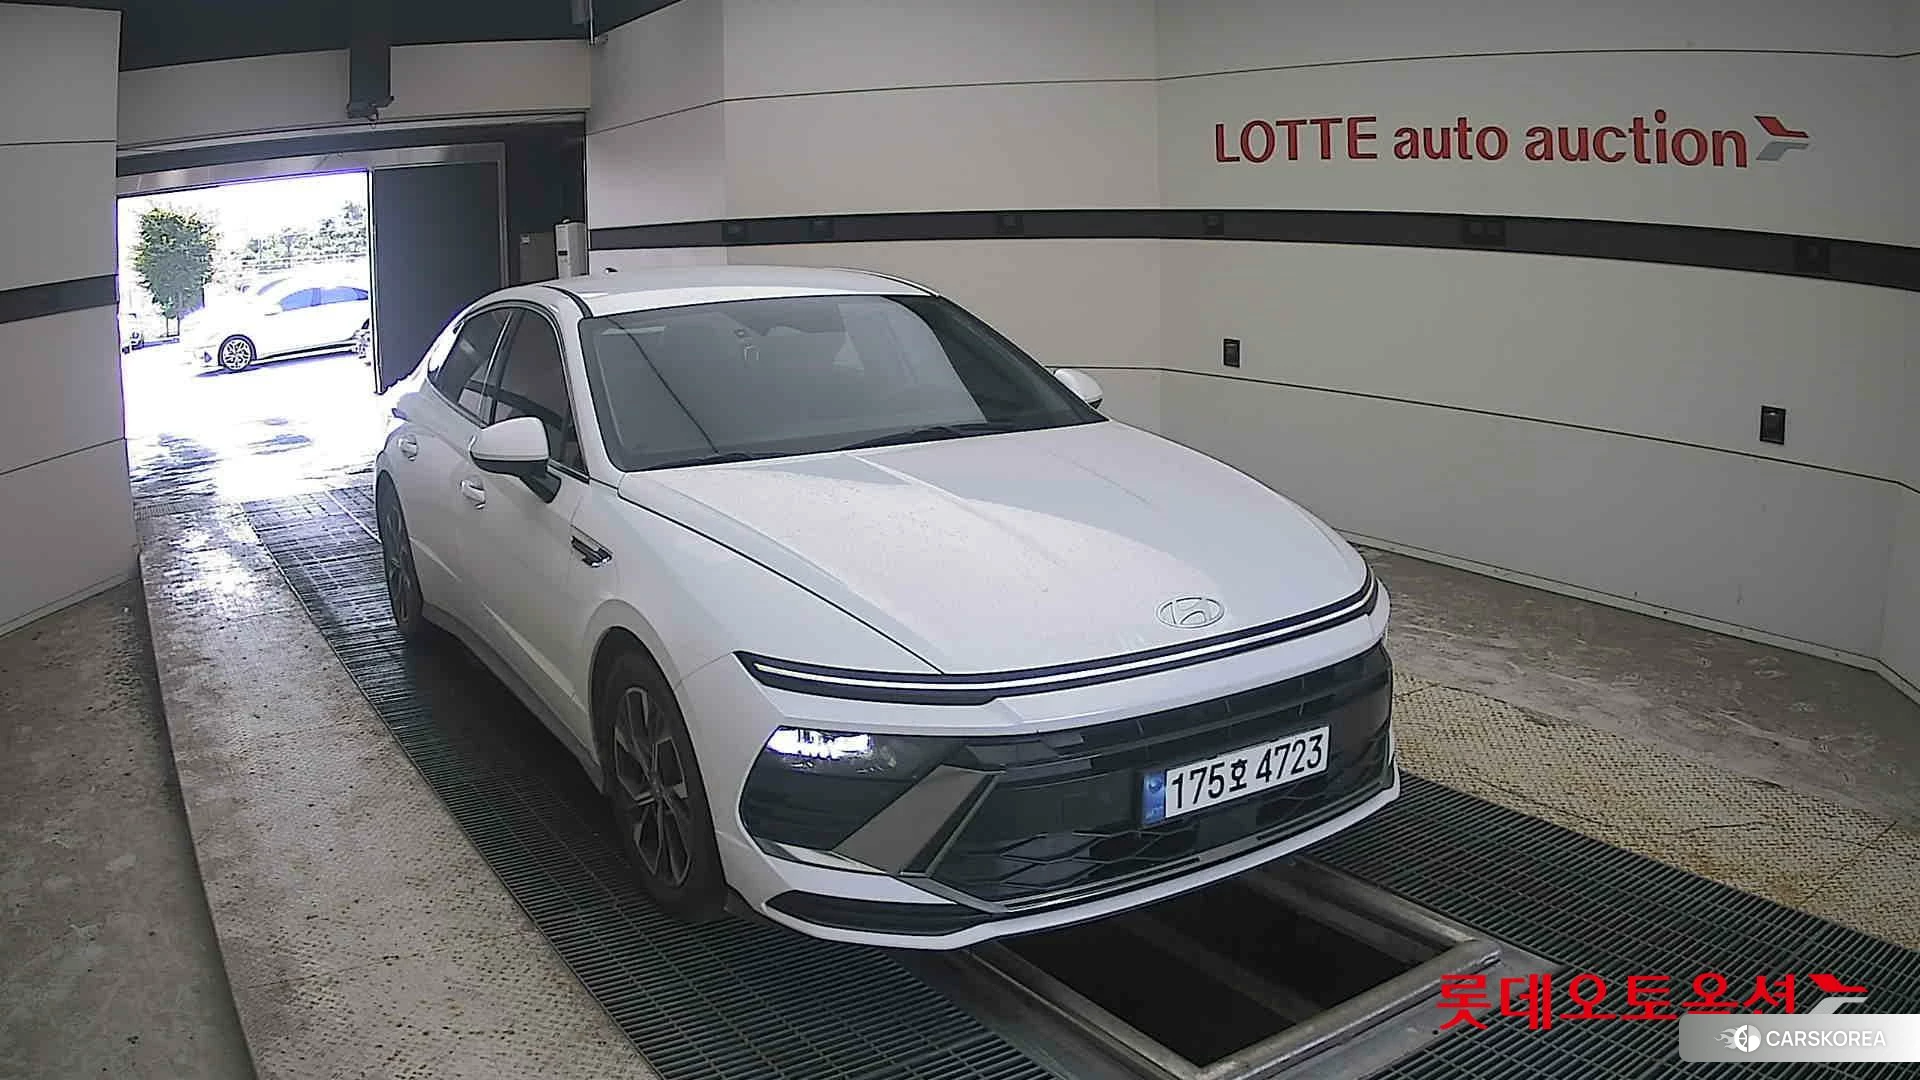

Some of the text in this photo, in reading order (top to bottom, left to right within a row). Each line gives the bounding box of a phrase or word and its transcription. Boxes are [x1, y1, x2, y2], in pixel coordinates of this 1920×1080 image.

[1215, 109, 1748, 168] LOTTE auto auction
[1172, 734, 1323, 809] 175호 4723
